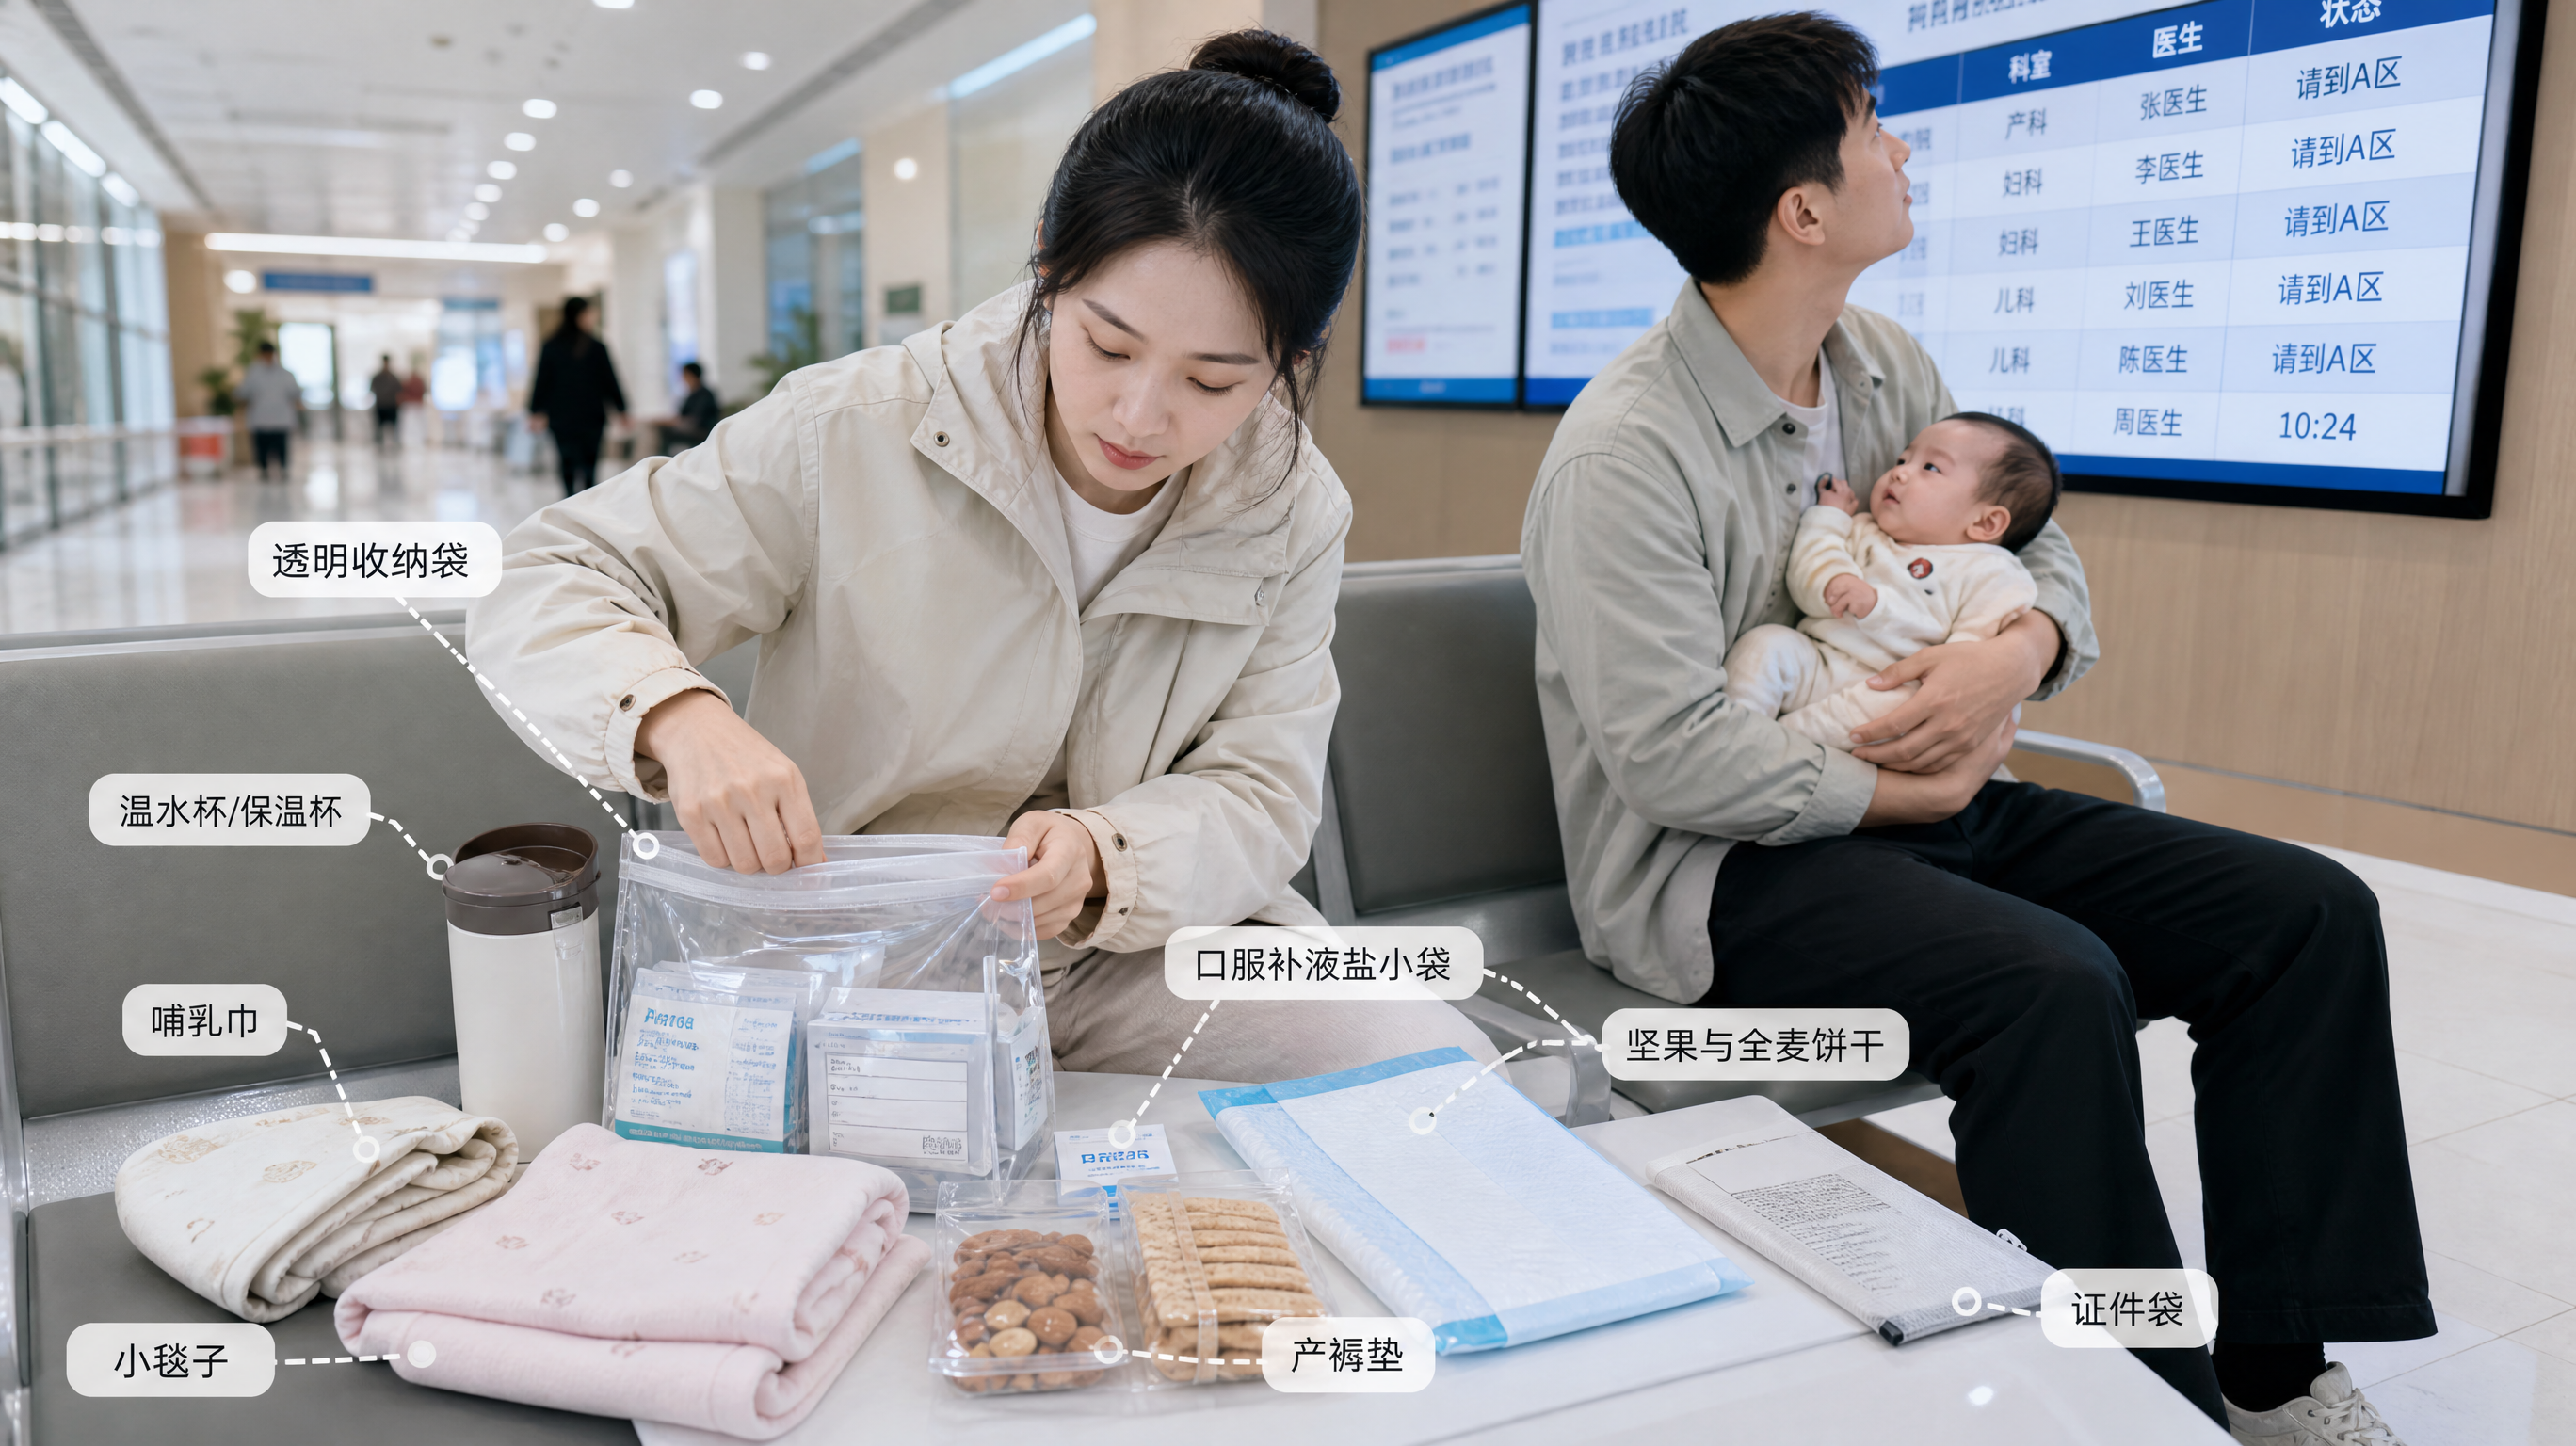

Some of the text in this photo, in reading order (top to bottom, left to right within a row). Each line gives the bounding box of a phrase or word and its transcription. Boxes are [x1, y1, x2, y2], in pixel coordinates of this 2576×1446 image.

[2319, 0, 2383, 29] 状态
[2151, 20, 2204, 59] 医生
[2007, 49, 2053, 85] 科室
[2296, 55, 2403, 101] 请到A区
[2139, 83, 2208, 121] 张医生
[2004, 107, 2048, 140] 产科
[2291, 128, 2397, 169] 请到A区
[2002, 167, 2043, 199] 妇科
[2134, 149, 2204, 185] 李医生
[2129, 215, 2199, 248] 王医生
[2284, 200, 2391, 238] 请到A区
[1997, 227, 2039, 257] 妇科
[1993, 286, 2035, 314] 儿科
[2123, 279, 2195, 311] 刘医生
[2278, 271, 2385, 306] 请到A区
[1988, 346, 2031, 375] 儿科
[2117, 344, 2189, 375] 陈医生
[2272, 343, 2377, 375] 请到A区
[2112, 407, 2183, 437] 周医生
[2278, 411, 2357, 442] 10:24
